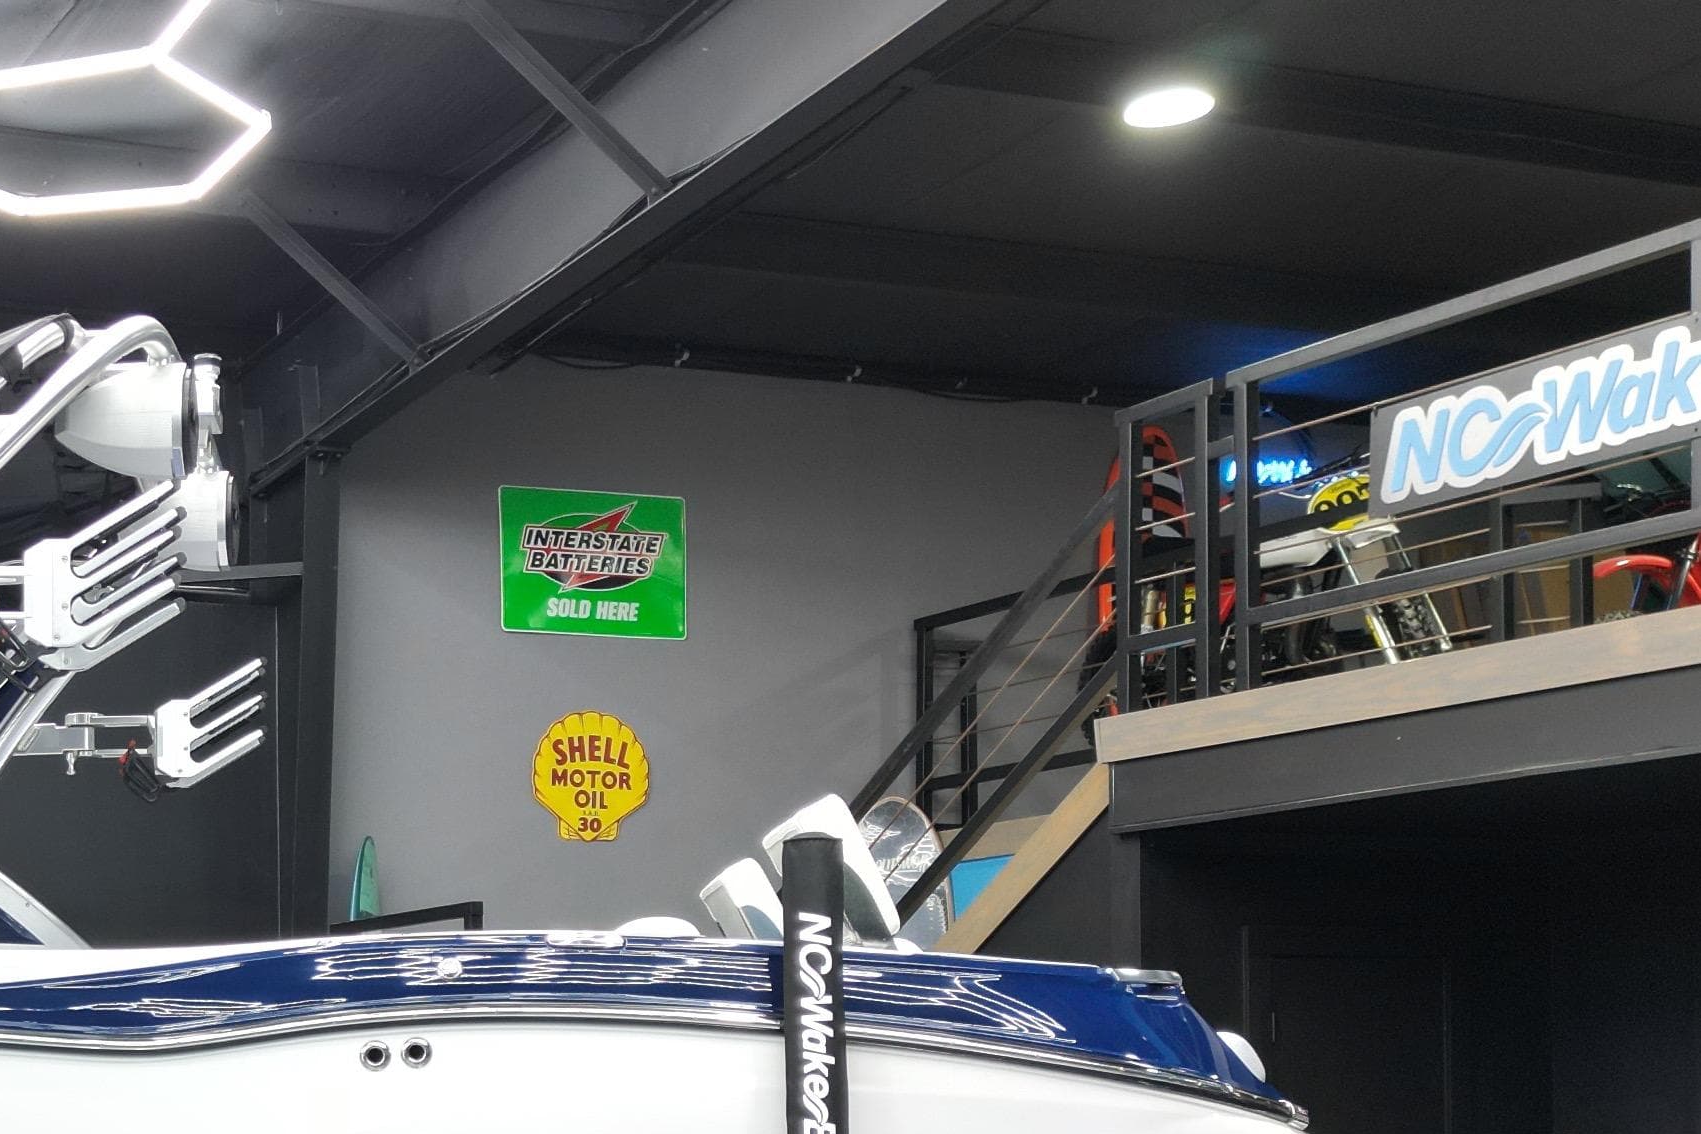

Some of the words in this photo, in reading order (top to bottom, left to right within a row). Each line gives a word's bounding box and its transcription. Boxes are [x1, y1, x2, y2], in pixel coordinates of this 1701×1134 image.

[524, 527, 663, 555] INTERSTATE
[529, 550, 651, 576] BATTERIES
[546, 597, 590, 619] SOLD
[596, 600, 640, 622] HERE
[551, 734, 631, 770] SHELL
[551, 768, 632, 790] MOTOR
[574, 789, 609, 809] OIL
[577, 816, 603, 833] 30
